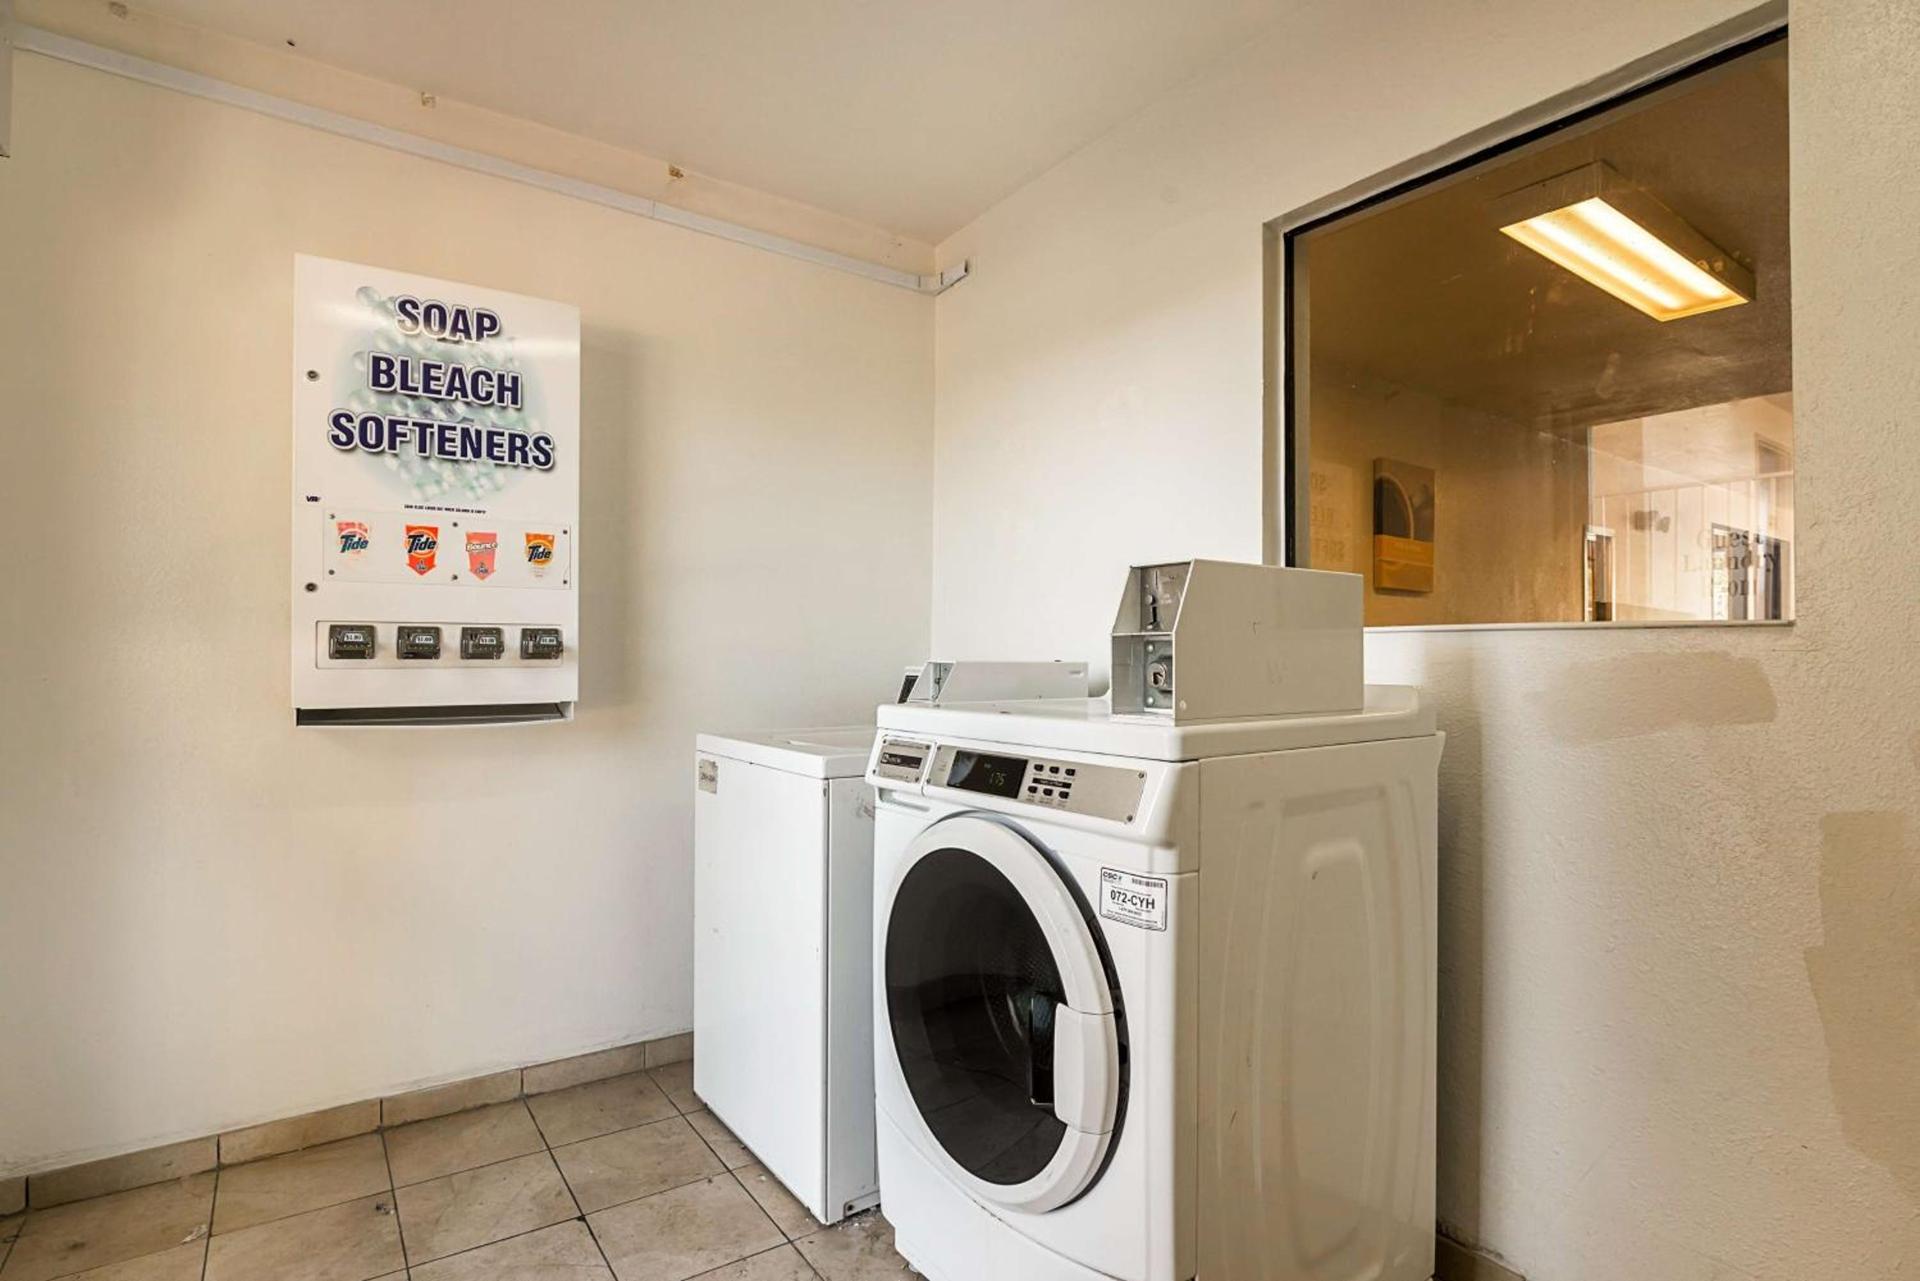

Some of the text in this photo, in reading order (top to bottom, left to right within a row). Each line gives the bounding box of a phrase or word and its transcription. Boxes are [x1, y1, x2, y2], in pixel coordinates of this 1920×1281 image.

[396, 297, 501, 343] SOAP
[369, 353, 523, 408] BLEACH
[328, 408, 556, 470] SOFTENERS
[340, 534, 369, 553] Tide
[407, 534, 437, 553] Tide
[528, 545, 553, 562] Tide
[1110, 889, 1155, 910] 072-CYH
